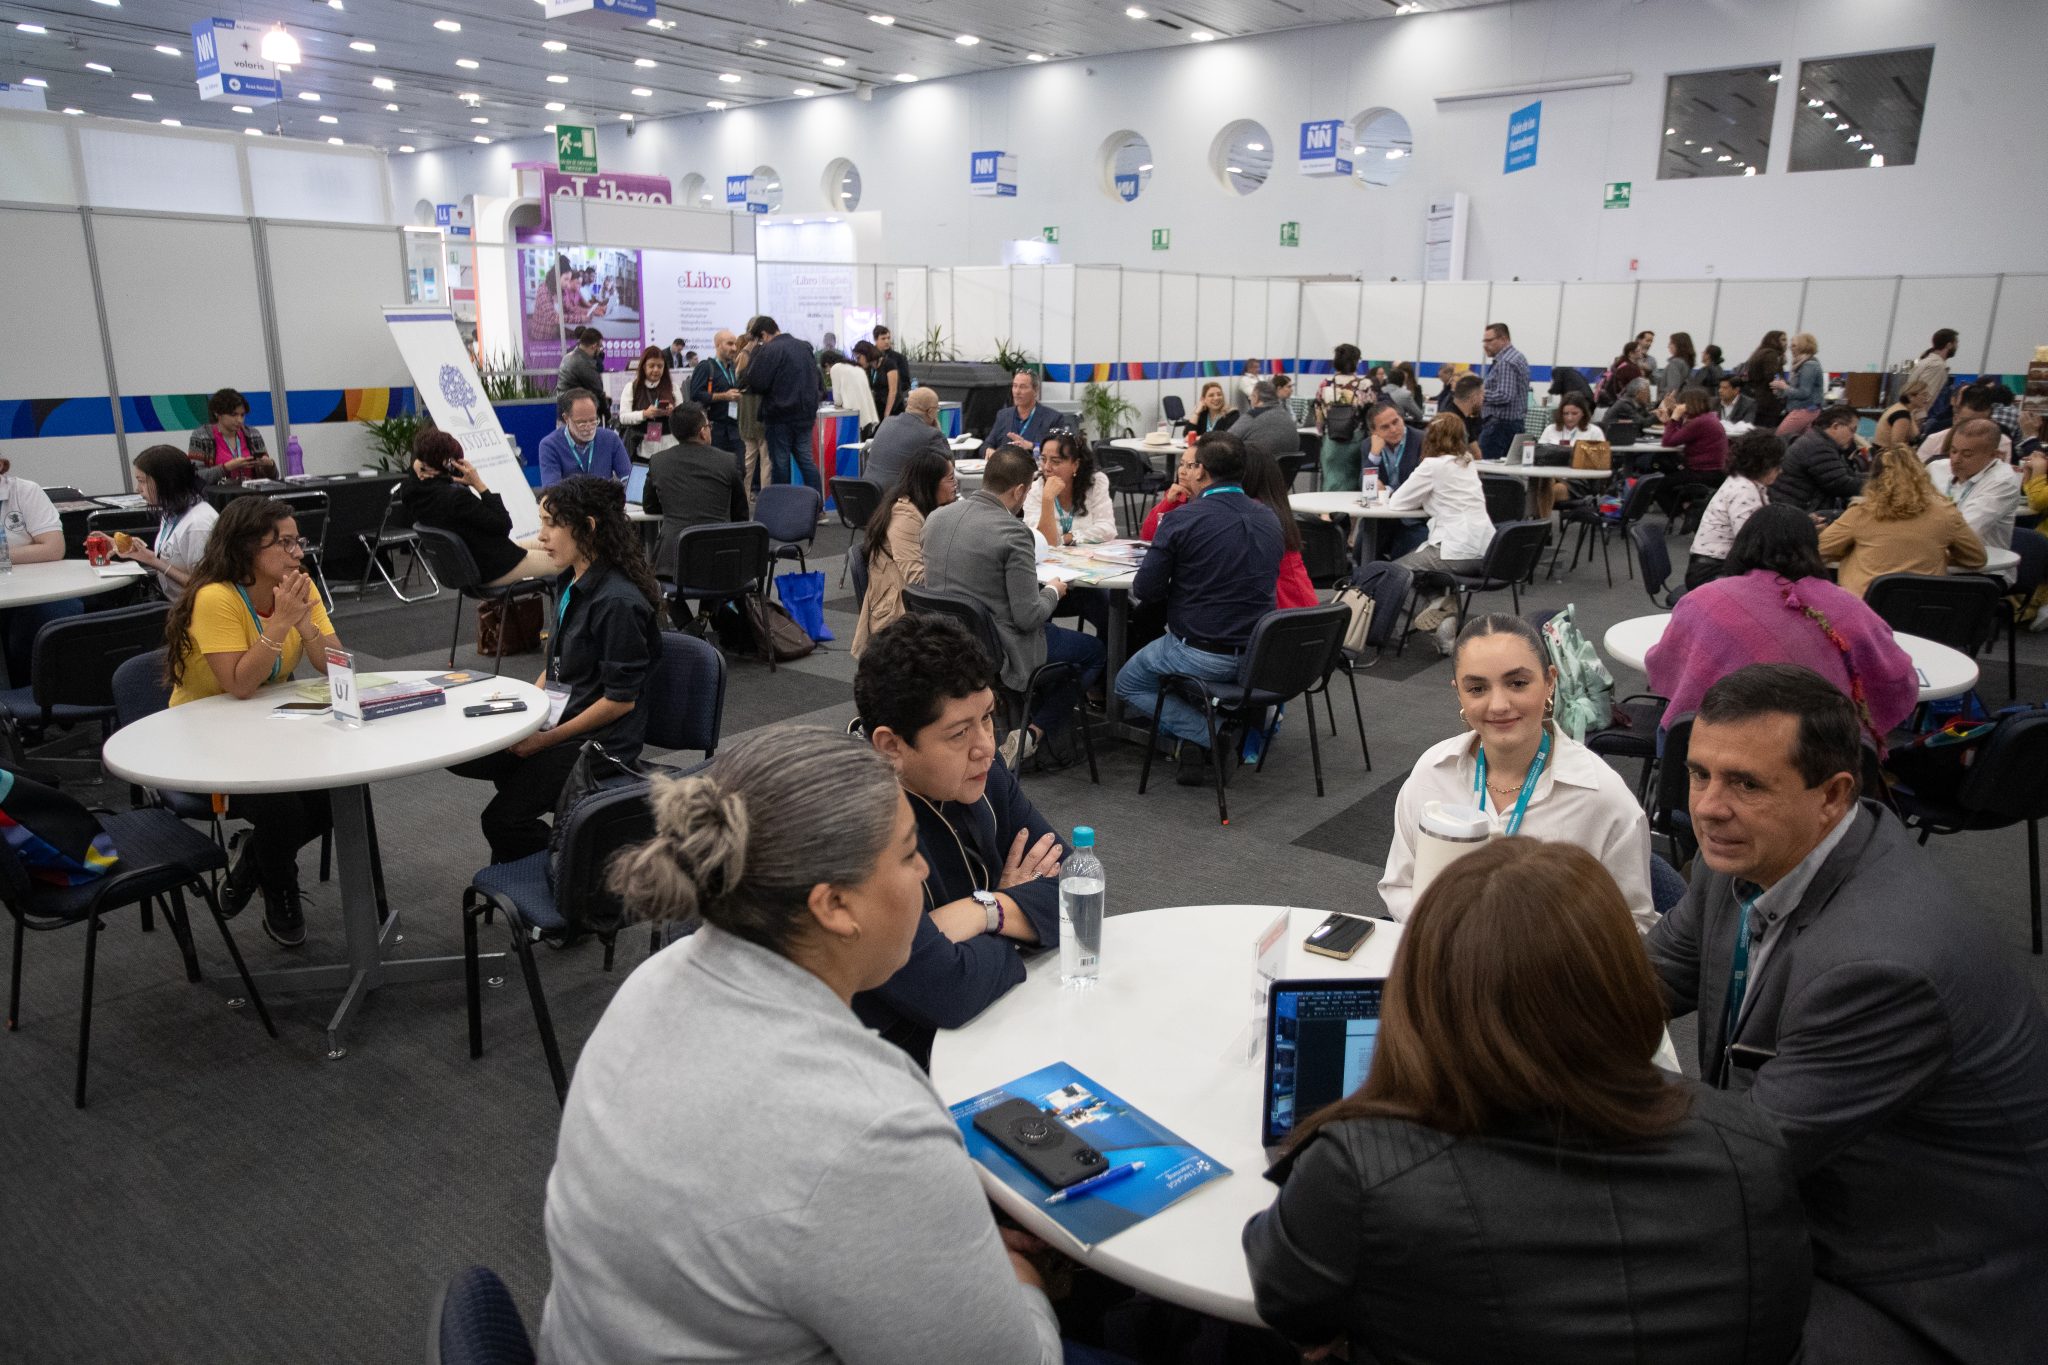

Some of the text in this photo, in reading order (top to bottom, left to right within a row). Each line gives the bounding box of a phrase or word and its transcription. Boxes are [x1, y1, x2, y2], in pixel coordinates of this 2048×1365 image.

[196, 31, 214, 62] NN
[234, 60, 265, 71] volaris
[1307, 124, 1332, 149] ÑÑ
[975, 158, 994, 175] NN
[677, 271, 731, 289] eLibro
